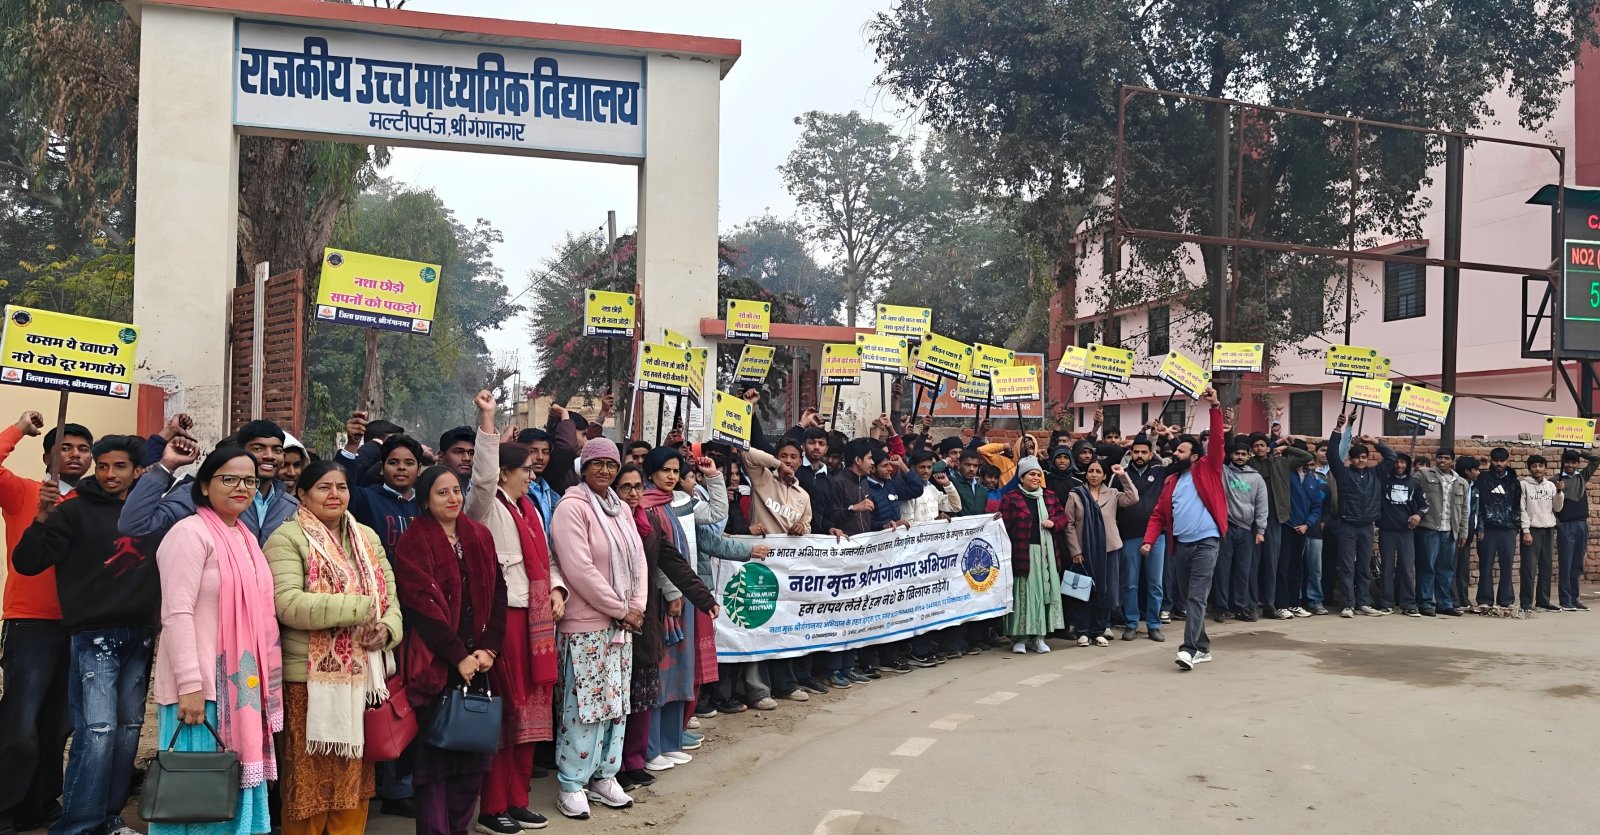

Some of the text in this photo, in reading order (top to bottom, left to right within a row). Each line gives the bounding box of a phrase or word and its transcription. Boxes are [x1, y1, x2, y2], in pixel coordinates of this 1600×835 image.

[241, 36, 640, 126] राजकीय उच्च माध्यमिक विद्यालय
[1571, 247, 1595, 265] NO2
[354, 277, 405, 294] नशा छोड़ो
[330, 292, 421, 315] सपनों को पकड़ो!
[339, 310, 354, 320] जिला
[378, 317, 410, 328] श्रीगंगानगर
[26, 333, 64, 347] कसम
[66, 337, 78, 350] ये
[12, 350, 35, 363] नशे
[38, 354, 57, 366] को
[60, 359, 77, 371] दूर
[26, 373, 107, 391] जिला प्रशासन, श्रीगंगानगर
[777, 548, 796, 557] भारत
[798, 546, 828, 558] अभियान
[830, 547, 838, 557] के
[916, 532, 945, 544] श्रीगंगानगर
[946, 530, 952, 539] के
[788, 576, 825, 592] नशा
[827, 573, 857, 597] मुक्त
[859, 562, 917, 588] श्रीगंगानगर
[919, 552, 958, 574] अभियान
[799, 604, 815, 616] हम
[817, 602, 843, 613] शपथ
[844, 598, 862, 611] लेते
[862, 595, 870, 611] हैं
[869, 597, 882, 610] हम
[882, 590, 896, 605] नशे
[897, 589, 906, 602] के
[906, 585, 931, 600] खिलाफ
[769, 626, 781, 634] नशा
[781, 625, 794, 634] मुक्त
[794, 621, 822, 632] श्रीगंगानगर
